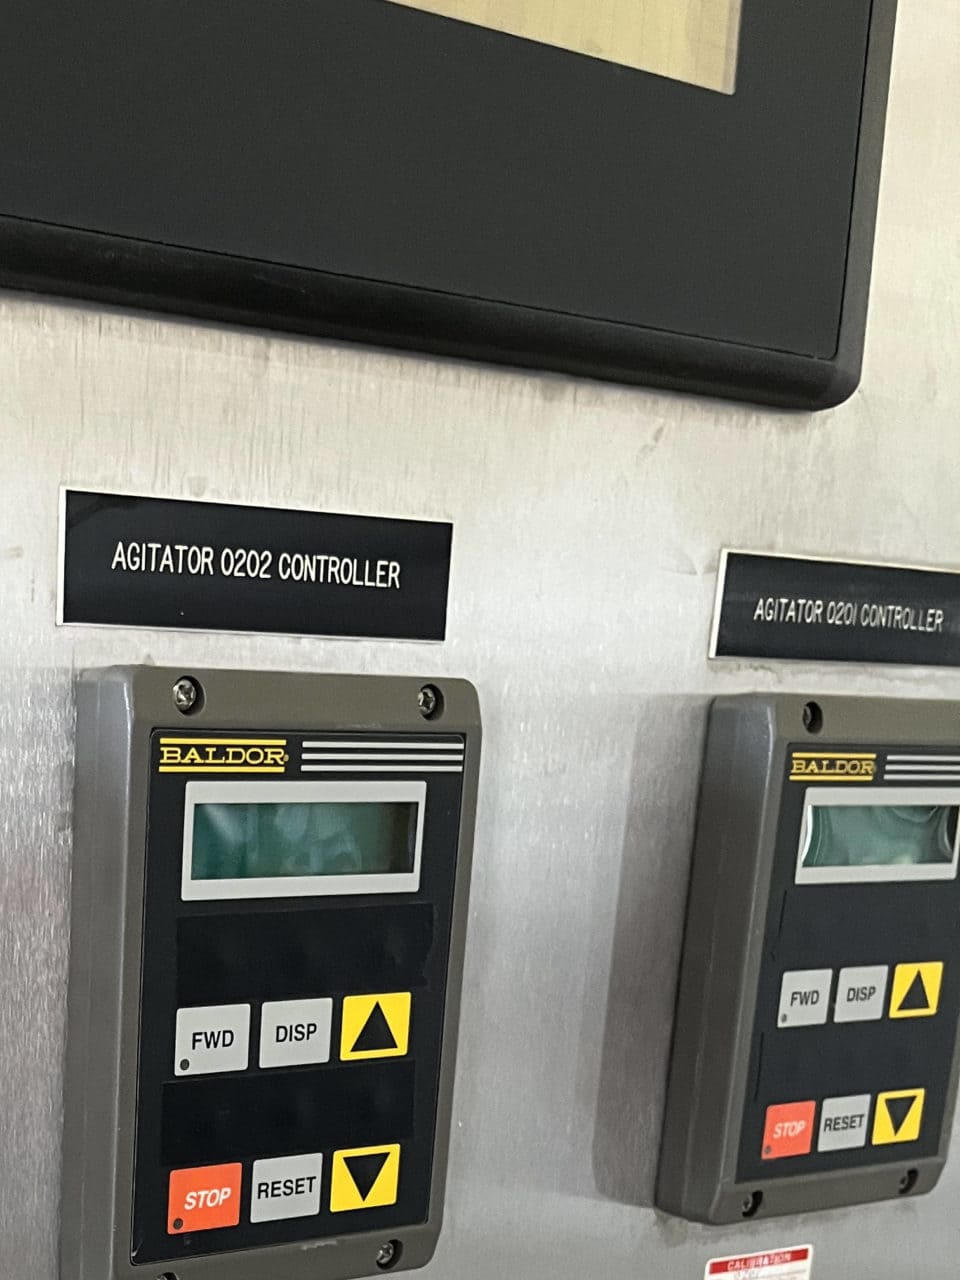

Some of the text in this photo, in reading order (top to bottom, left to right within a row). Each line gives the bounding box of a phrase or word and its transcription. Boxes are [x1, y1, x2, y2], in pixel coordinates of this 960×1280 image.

[110, 540, 401, 589] AGITATOR 0202 CONTROLLER
[753, 597, 824, 625] AGITATOR
[860, 603, 945, 633] CONTROLLER
[158, 746, 286, 766] BALDOR
[790, 760, 876, 776] BALDOR
[790, 989, 820, 1007] FWD
[846, 985, 877, 1002] DISP
[191, 1029, 235, 1050] FWD
[275, 1022, 318, 1043] DISP
[772, 1119, 807, 1140] STOP
[823, 1113, 865, 1133] RESET
[257, 1176, 317, 1200] RESET
[183, 1187, 232, 1211] STOP
[727, 1253, 792, 1272] CALIBRATION
